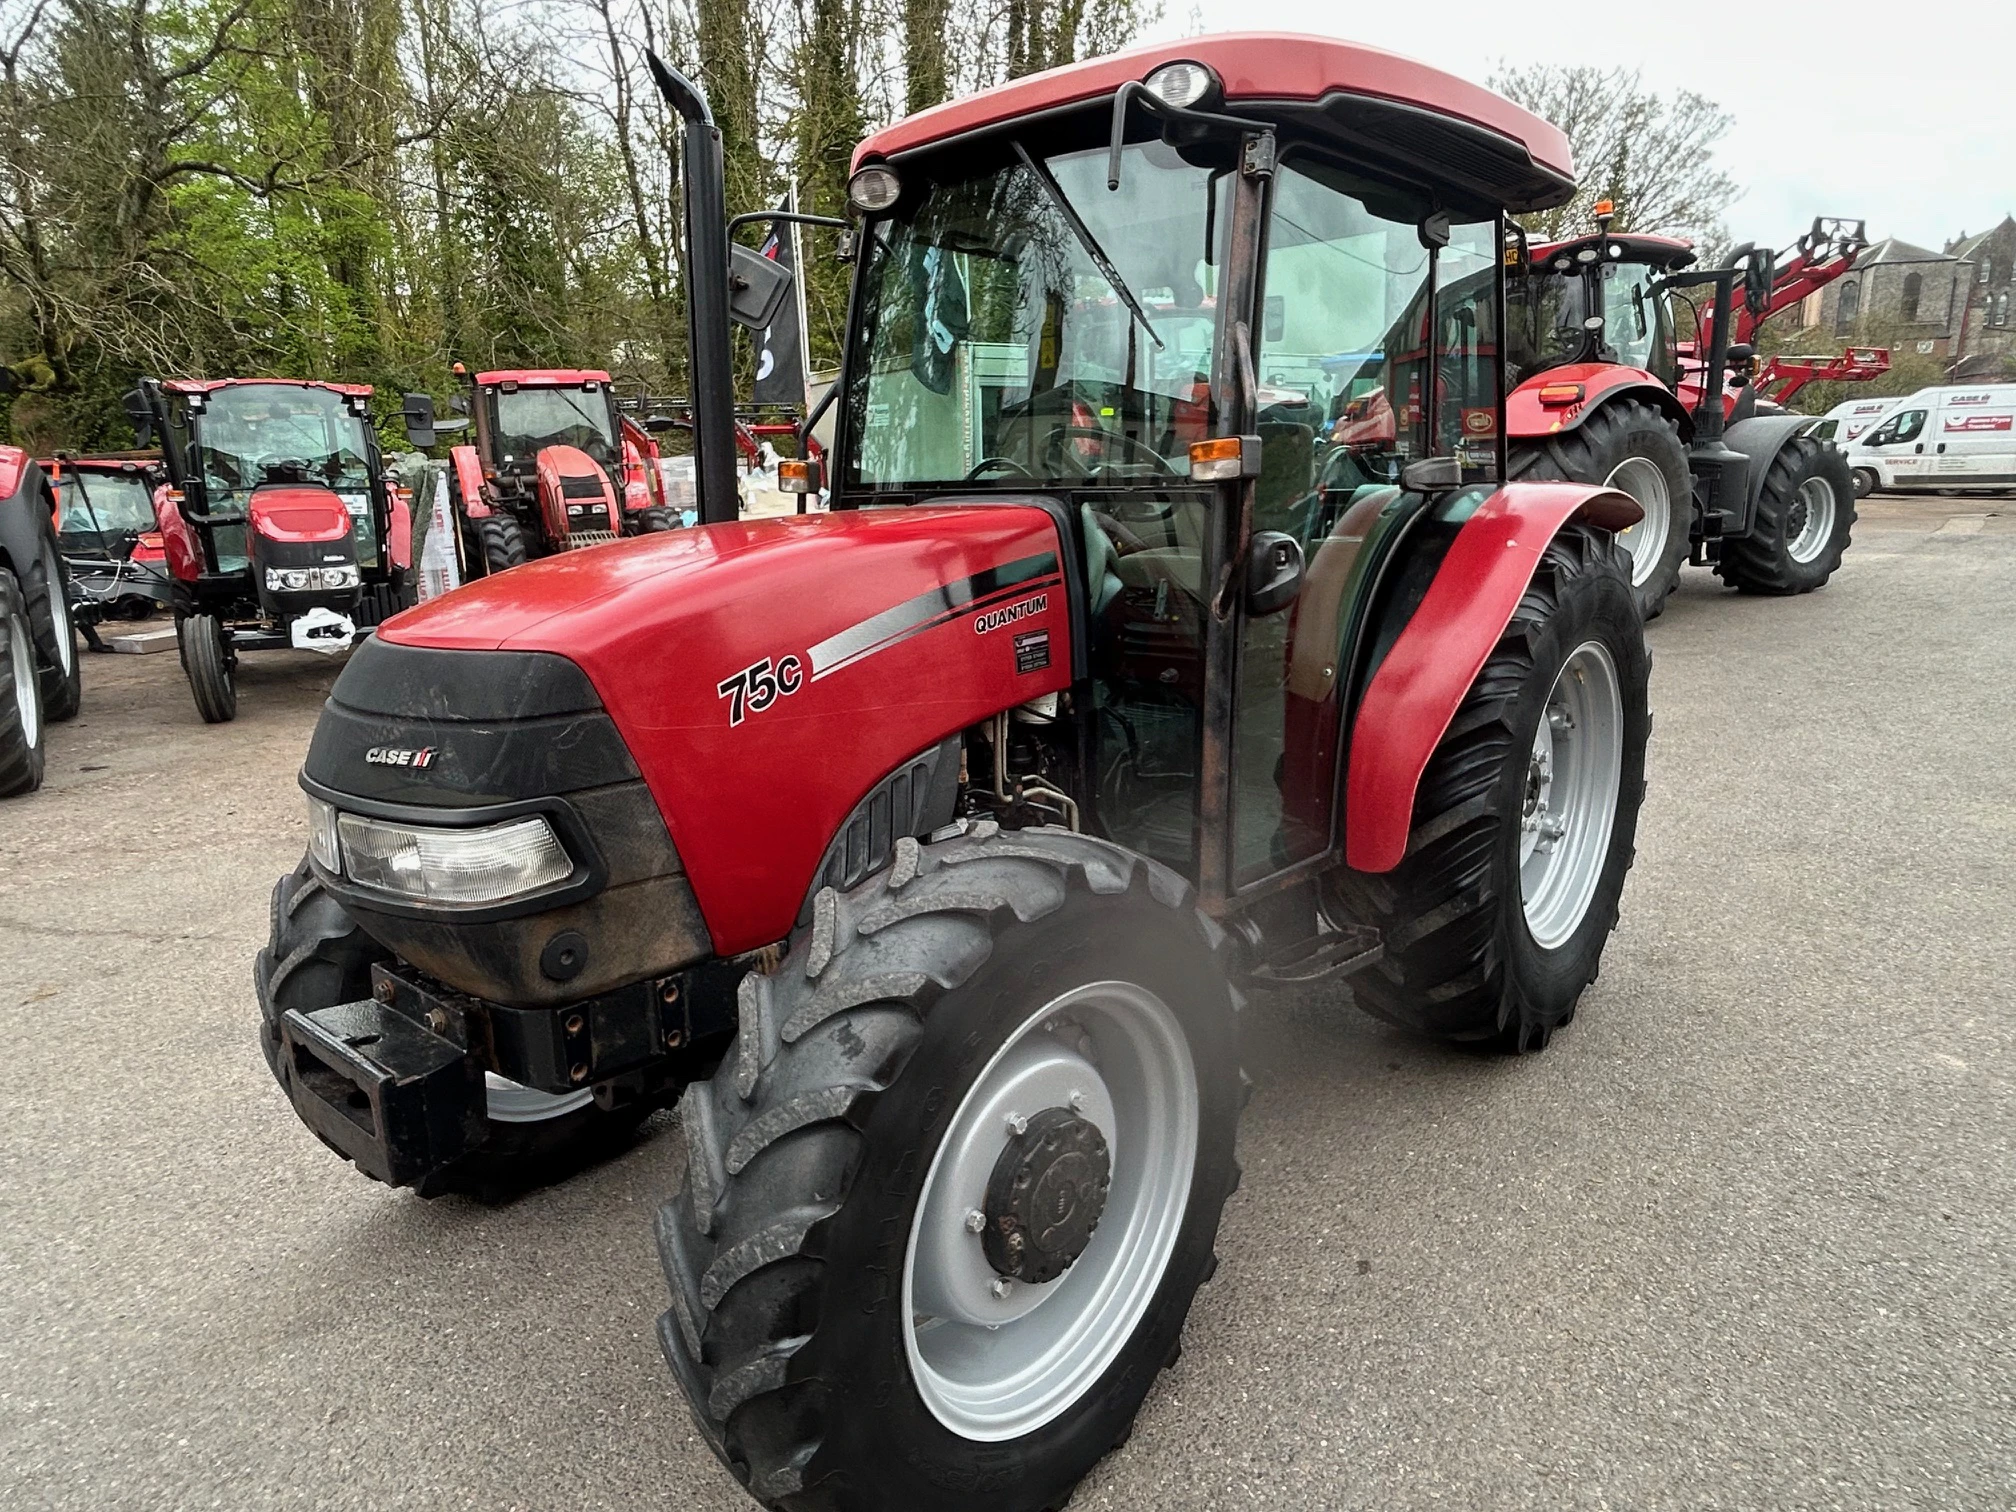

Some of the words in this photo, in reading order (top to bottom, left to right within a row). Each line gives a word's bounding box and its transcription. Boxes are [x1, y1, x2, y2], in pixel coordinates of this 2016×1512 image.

[974, 593, 1047, 635] QUANTUM
[716, 654, 803, 728] 75C
[365, 748, 412, 766] CASE
